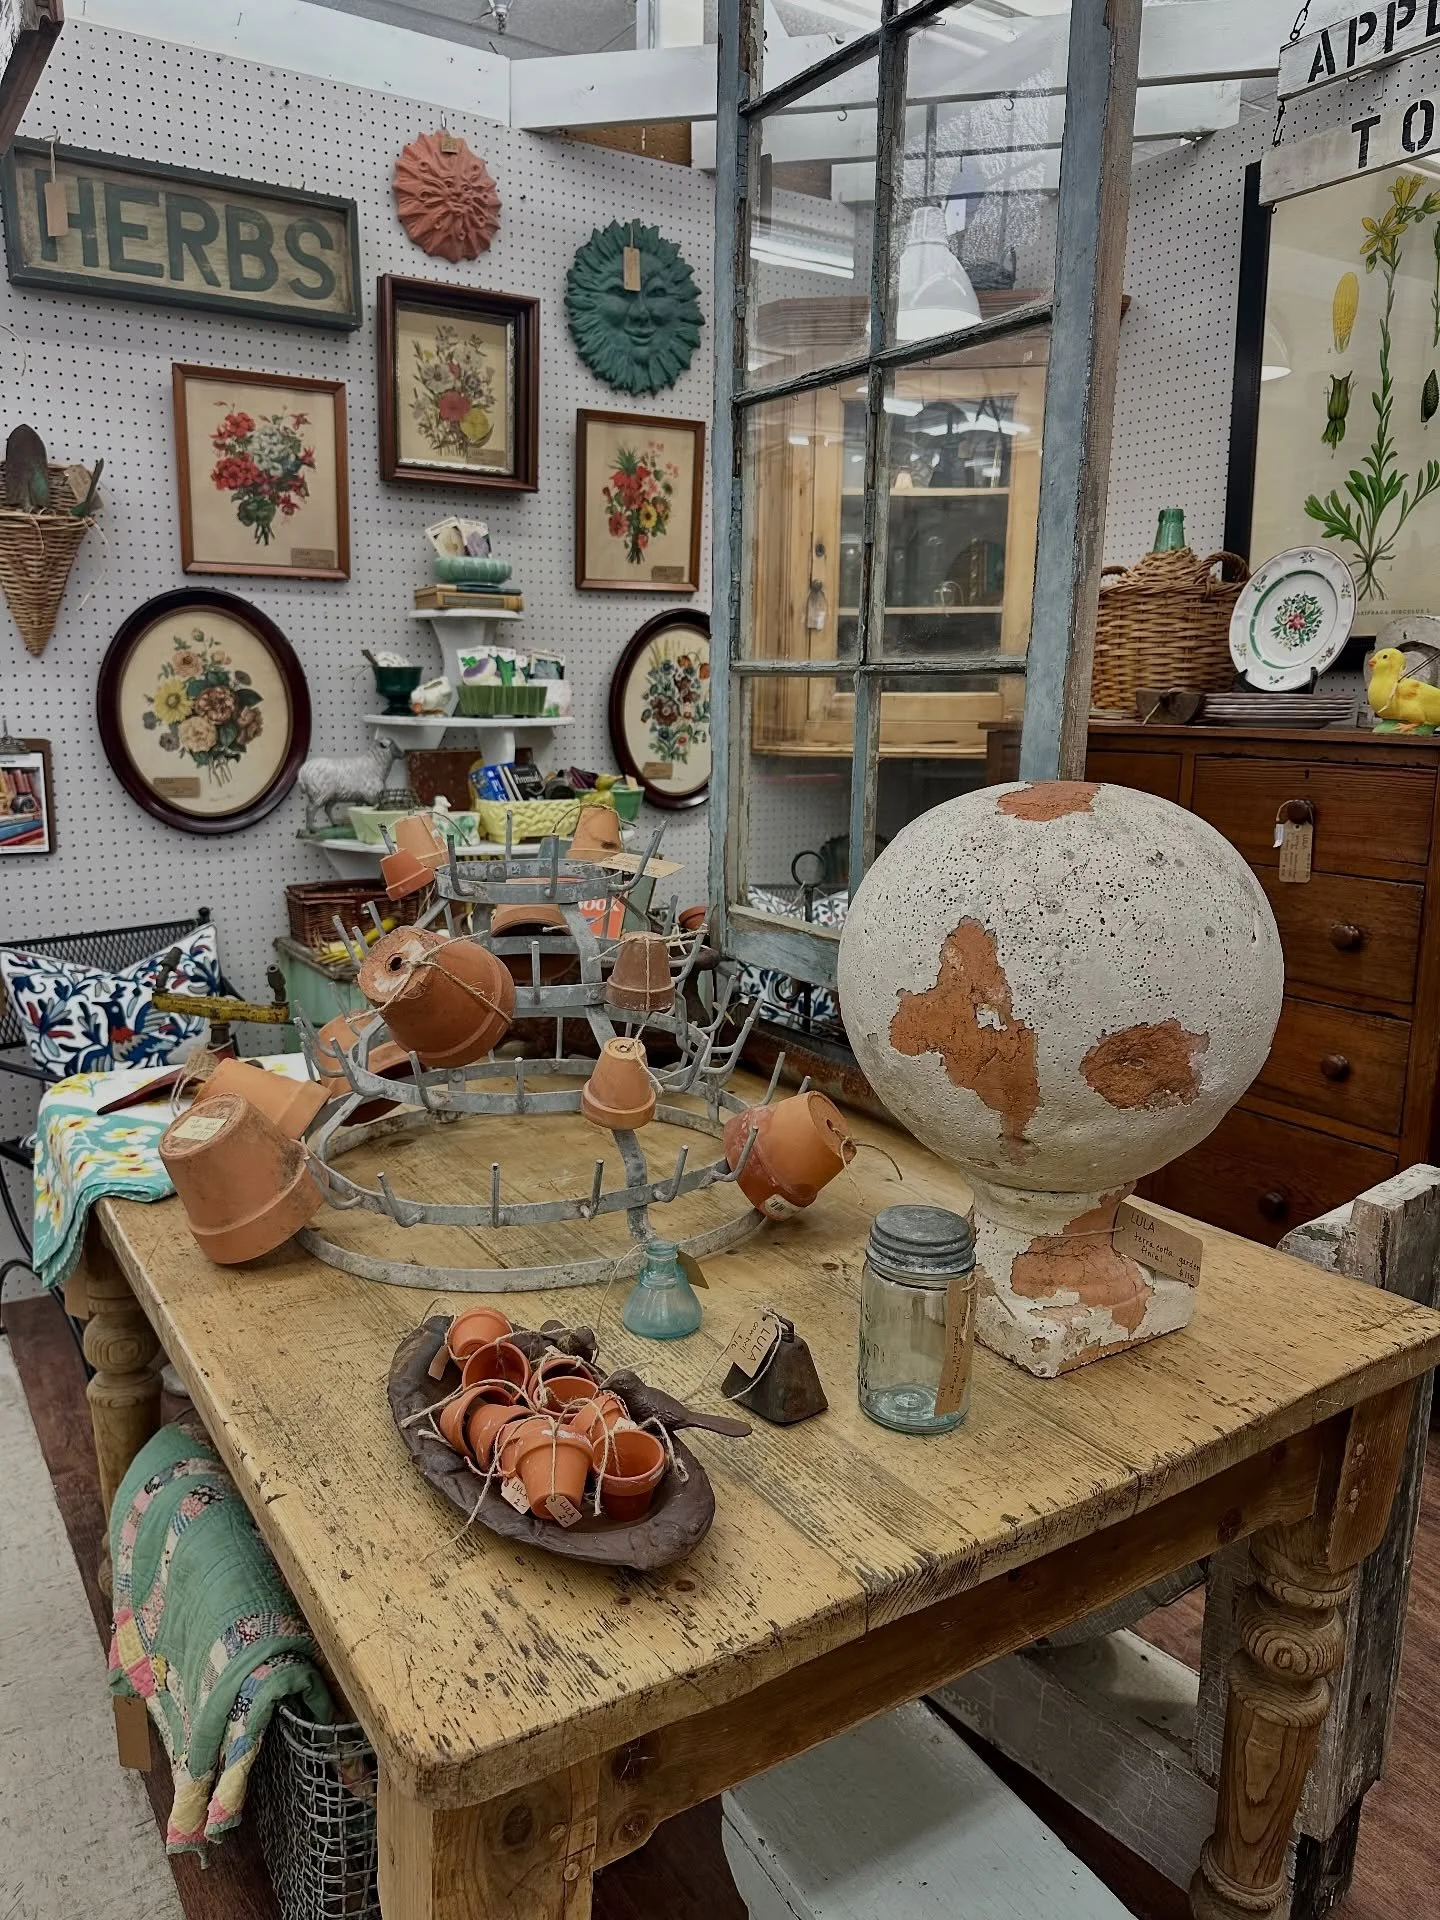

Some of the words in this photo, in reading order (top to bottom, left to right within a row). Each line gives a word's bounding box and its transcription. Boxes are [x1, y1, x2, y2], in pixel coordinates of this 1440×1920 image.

[34, 168, 338, 301] HERBS
[1130, 1211, 1155, 1233] LULA
[747, 1327, 771, 1361] LULA
[559, 1500, 577, 1520] LULA
